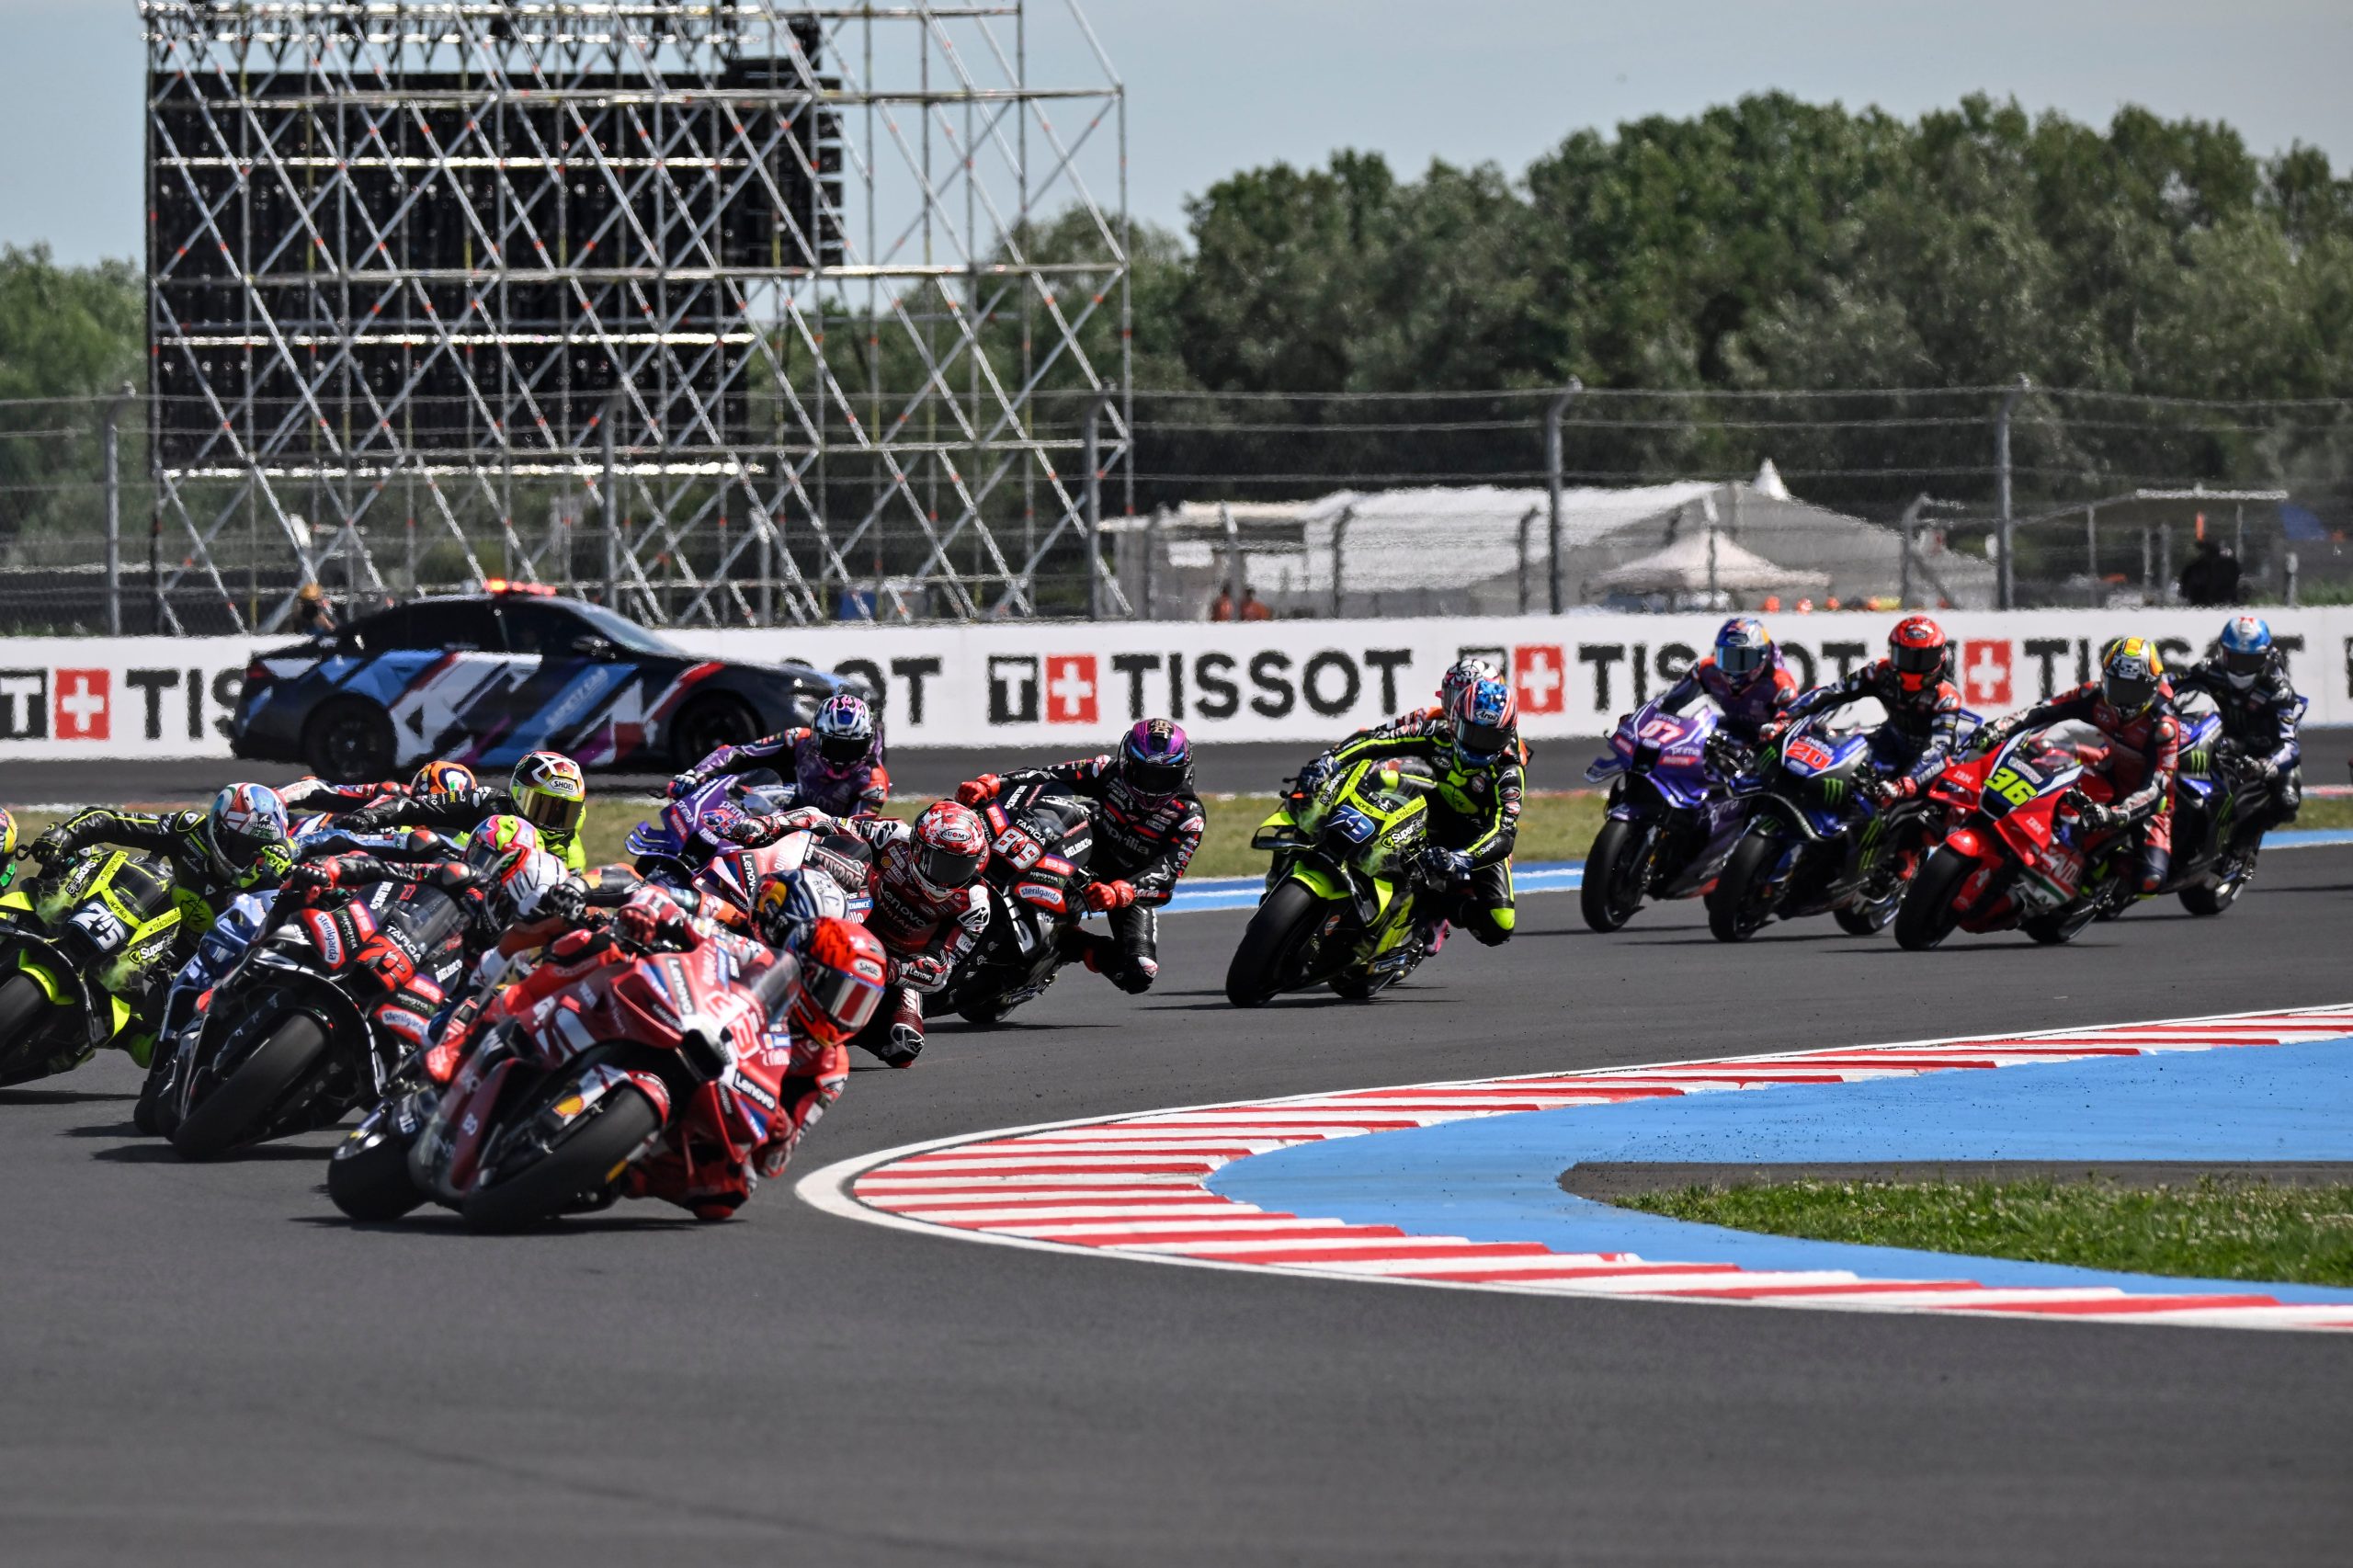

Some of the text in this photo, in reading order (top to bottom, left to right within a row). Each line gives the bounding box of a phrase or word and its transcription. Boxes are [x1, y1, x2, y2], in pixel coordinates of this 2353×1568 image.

[1110, 649, 1413, 720] TISSOT
[1639, 720, 1685, 744] 07
[1785, 740, 1835, 771] 20
[552, 780, 574, 791] SHOEI
[1984, 767, 2039, 807] 36
[1355, 800, 1374, 815] aprilia
[249, 821, 279, 833] SHARK
[943, 829, 970, 840] SUOMY
[1016, 818, 1047, 846] TARGA
[993, 826, 1043, 870] 89
[1029, 869, 1059, 882] MONSTER
[1044, 858, 1071, 874] BS
[1020, 886, 1060, 903] sterilgarda
[108, 900, 128, 920] aprilia
[152, 911, 182, 931] TRACKHOUSE
[68, 902, 129, 951] 25
[317, 915, 340, 961] sterilgarda
[386, 924, 423, 963] TARGA
[667, 959, 693, 1014] Lenovo
[909, 967, 934, 982] Lenovo
[734, 1073, 776, 1110] Lenovo
